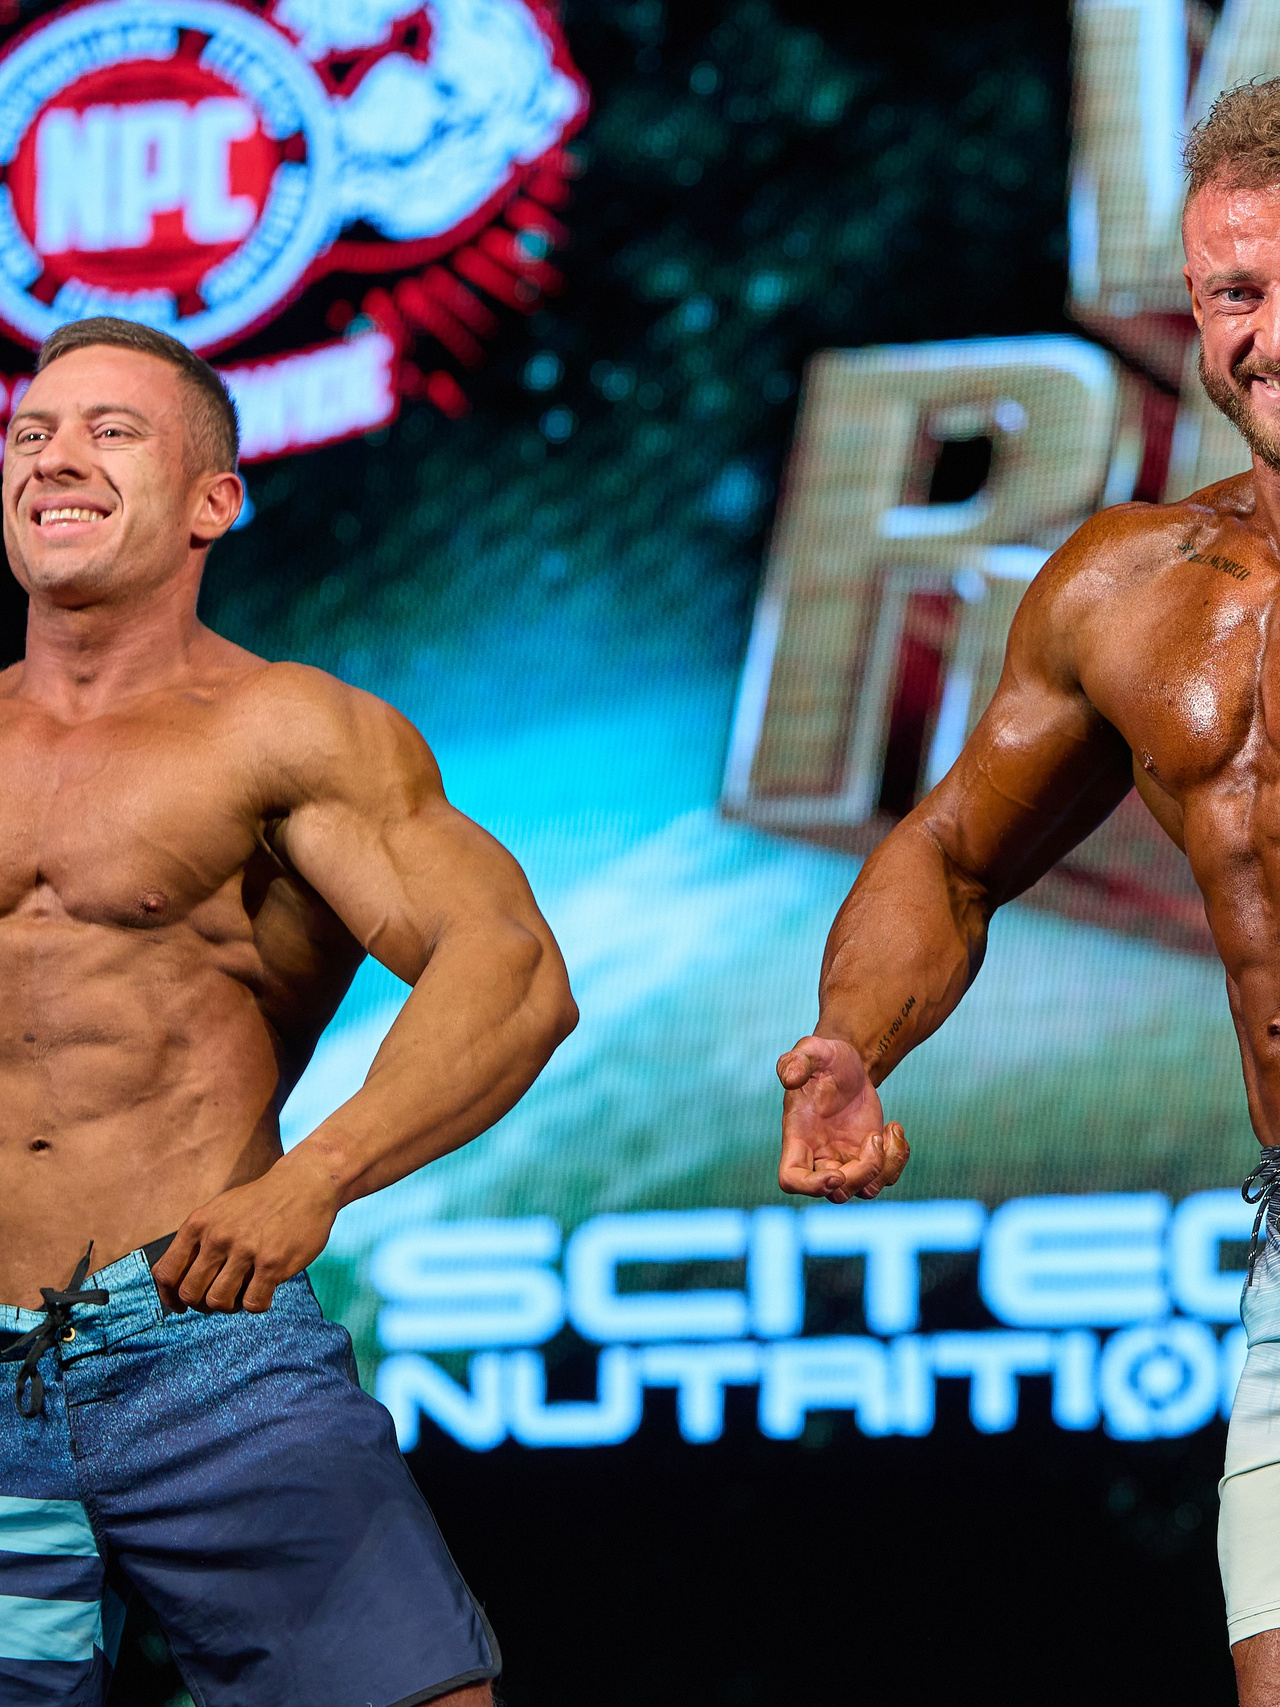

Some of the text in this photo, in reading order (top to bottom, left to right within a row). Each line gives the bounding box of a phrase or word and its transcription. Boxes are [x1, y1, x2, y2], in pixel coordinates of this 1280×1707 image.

[36, 97, 257, 253] NPC
[877, 995, 916, 1056] YES YOU CAN
[376, 1316, 1248, 1454] NUTRITIO
